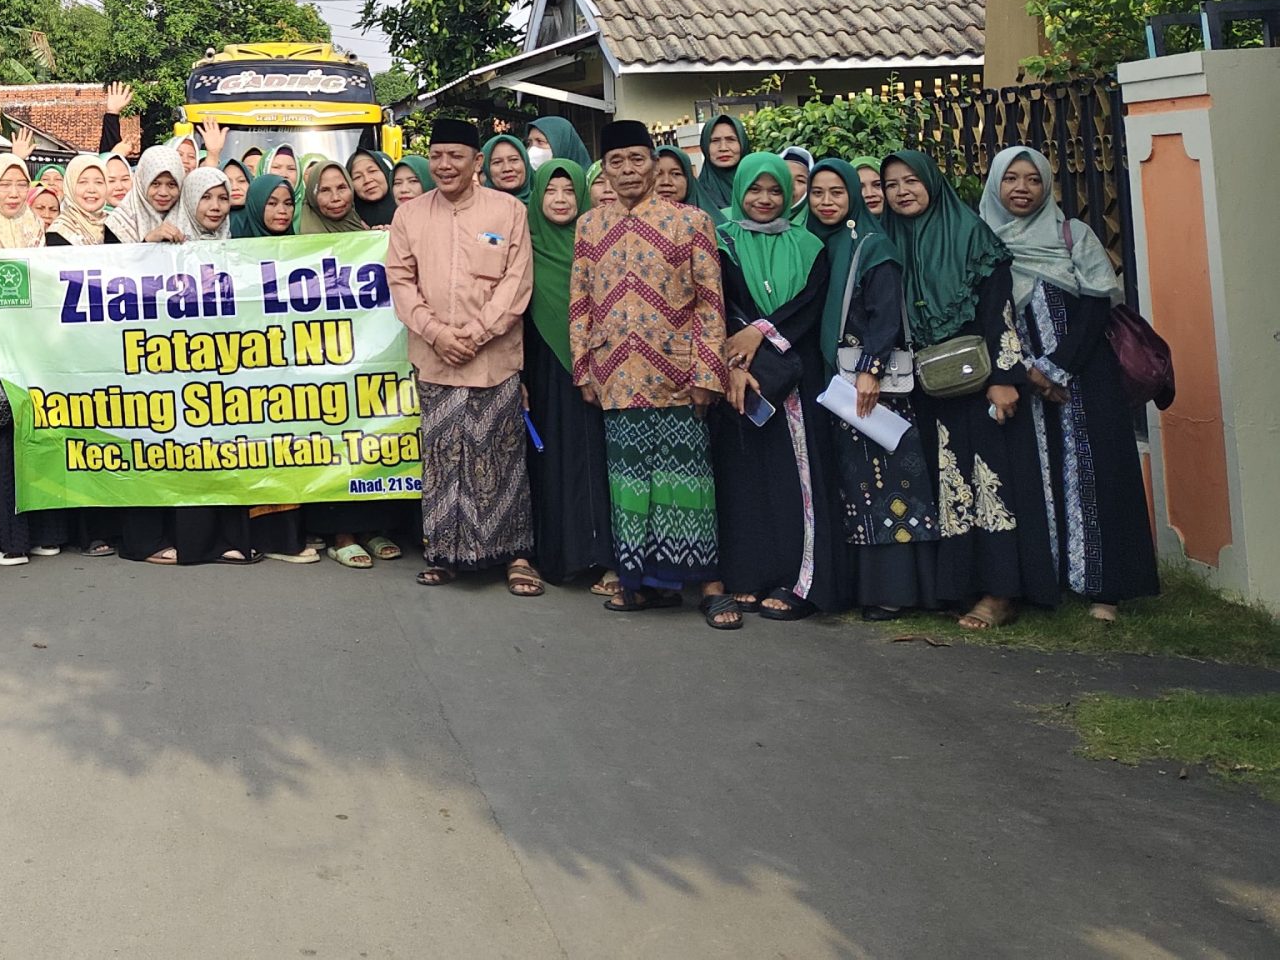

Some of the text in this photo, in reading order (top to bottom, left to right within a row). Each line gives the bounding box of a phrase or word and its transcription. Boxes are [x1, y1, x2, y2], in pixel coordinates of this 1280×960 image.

[219, 74, 344, 91] GADING
[59, 258, 391, 324] Ziarah Loka
[123, 319, 355, 375] Fatayat NU
[28, 385, 177, 433] Ranting
[182, 381, 349, 427] Slarang
[66, 437, 130, 471] Kec.
[131, 435, 269, 471] Lebaksiu
[272, 431, 341, 466] Kab.
[349, 478, 386, 493] Ahad,
[388, 477, 403, 492] 21
